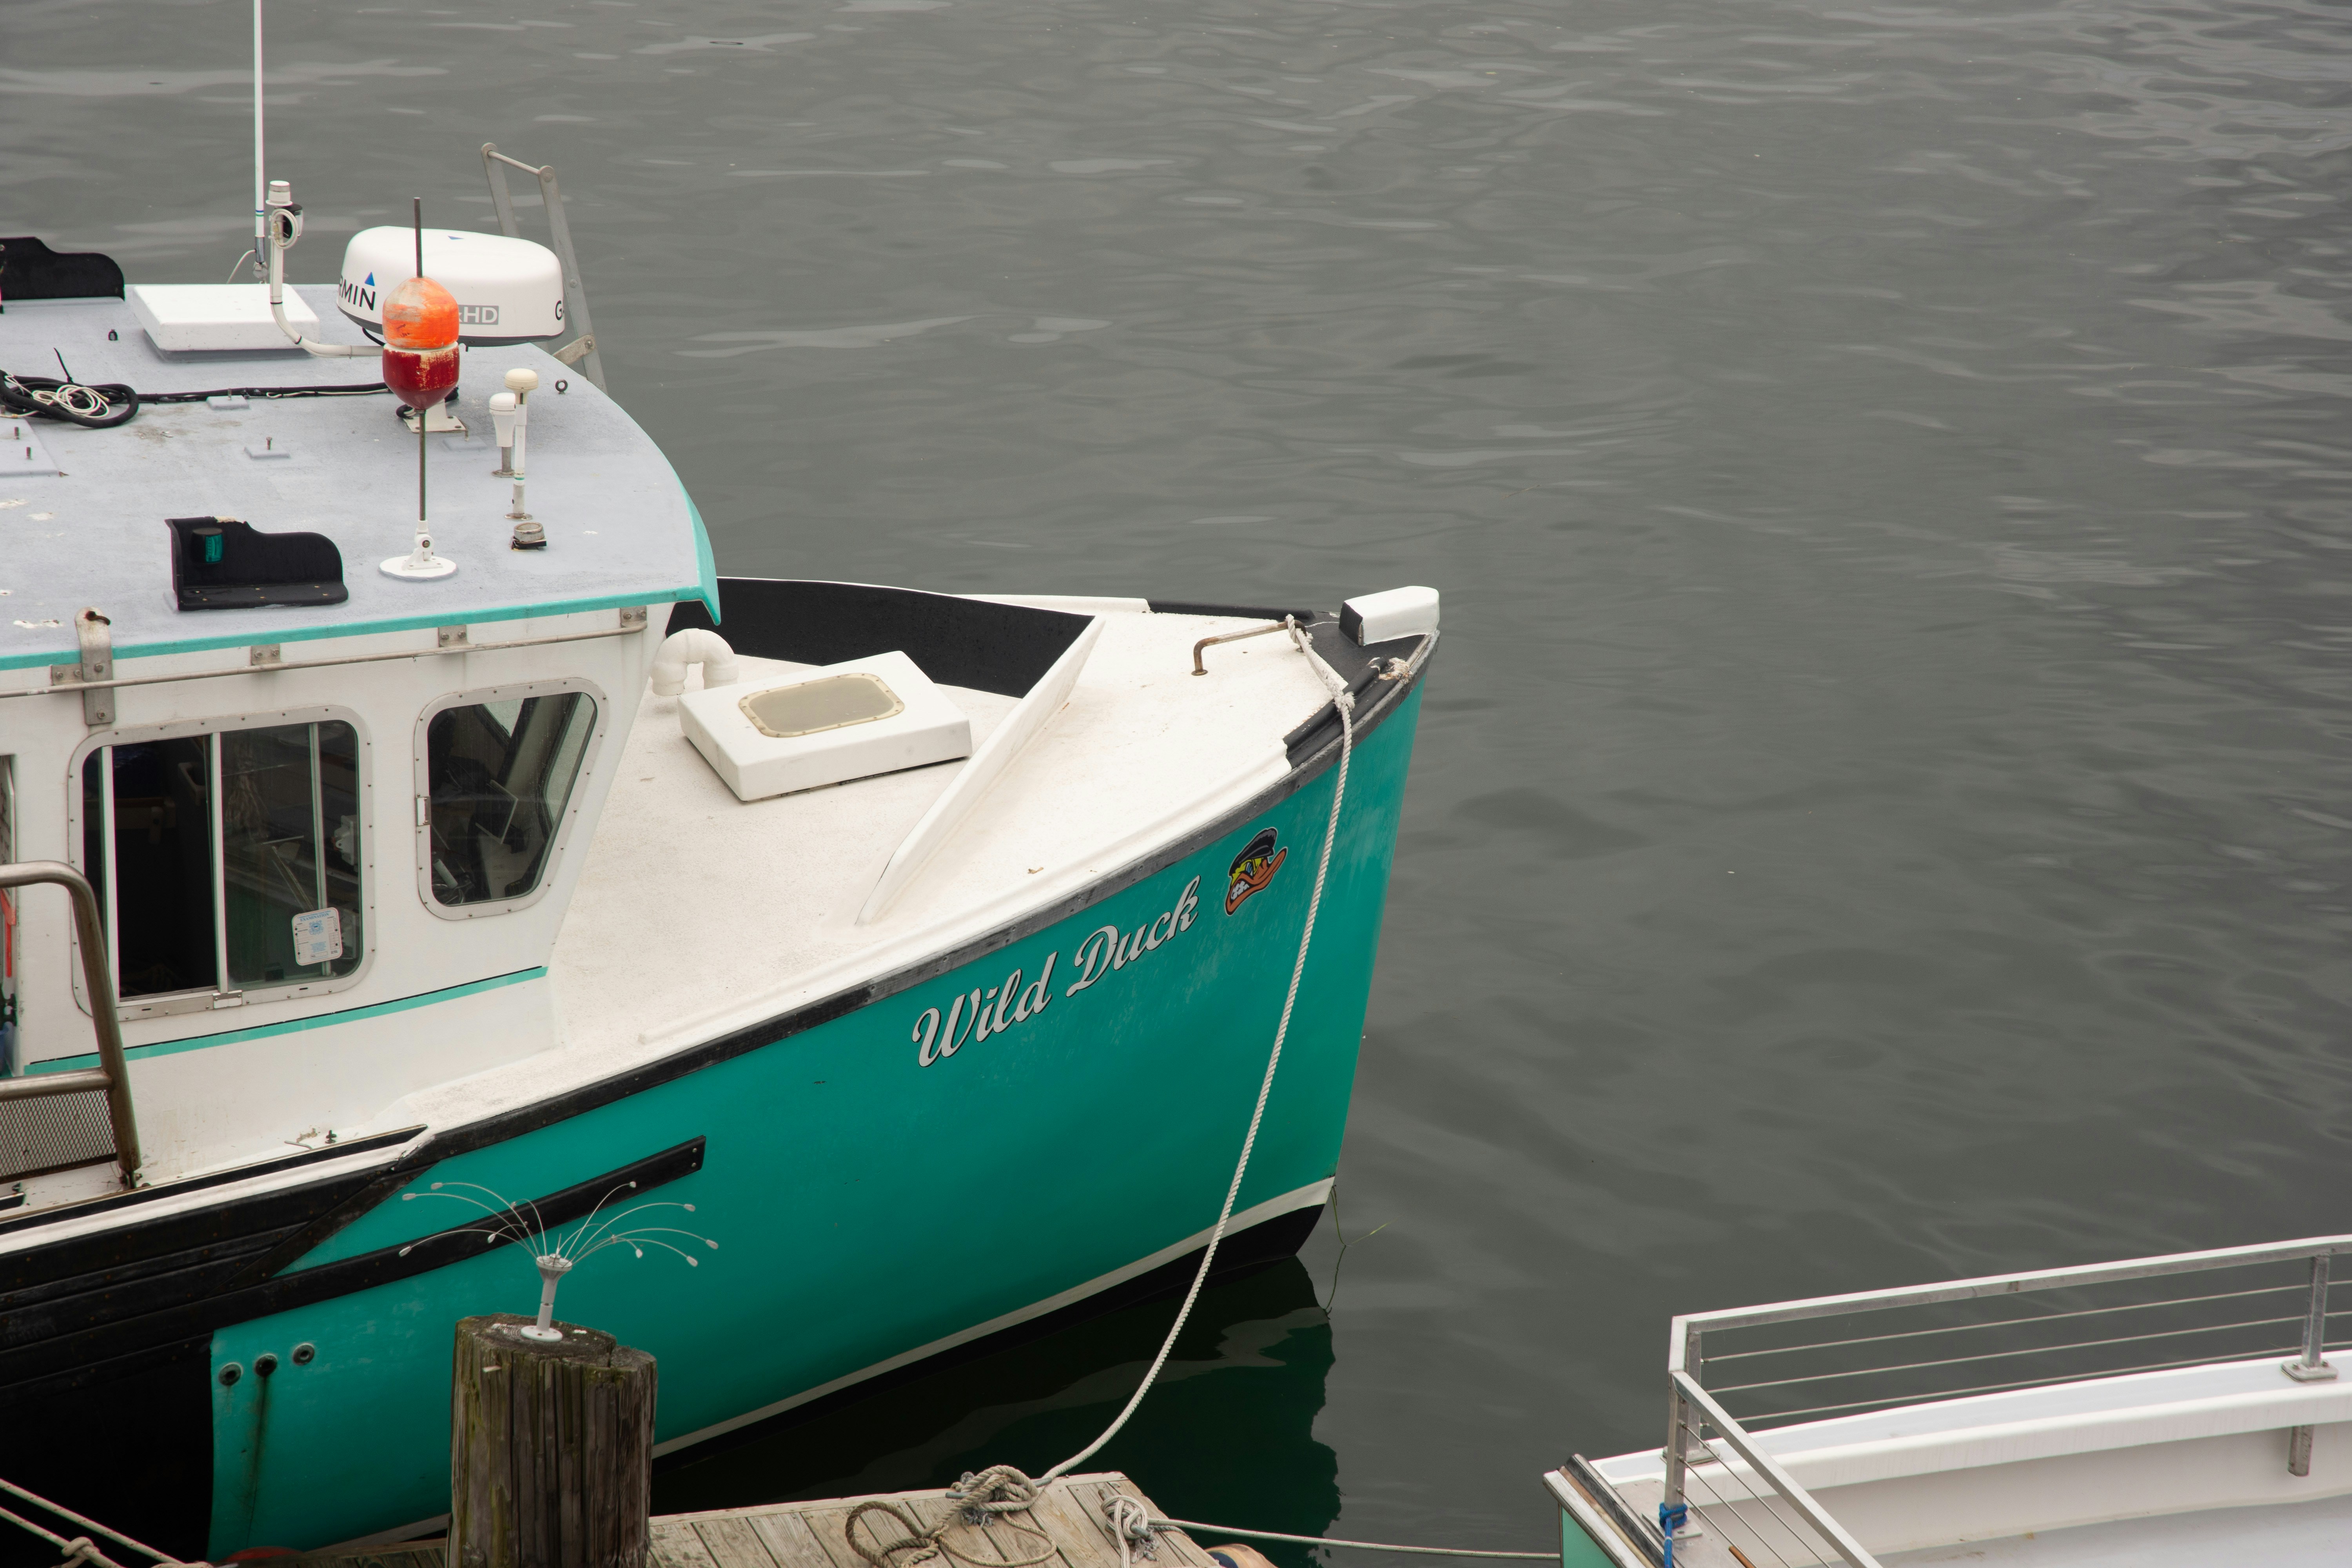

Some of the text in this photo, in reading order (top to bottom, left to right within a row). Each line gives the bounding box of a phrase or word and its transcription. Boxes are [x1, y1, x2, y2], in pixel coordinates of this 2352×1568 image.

[338, 275, 375, 311] RMIN
[555, 300, 564, 321] G
[301, 913, 329, 921] EXAMINATION
[911, 875, 1201, 1067] Wild Duck
